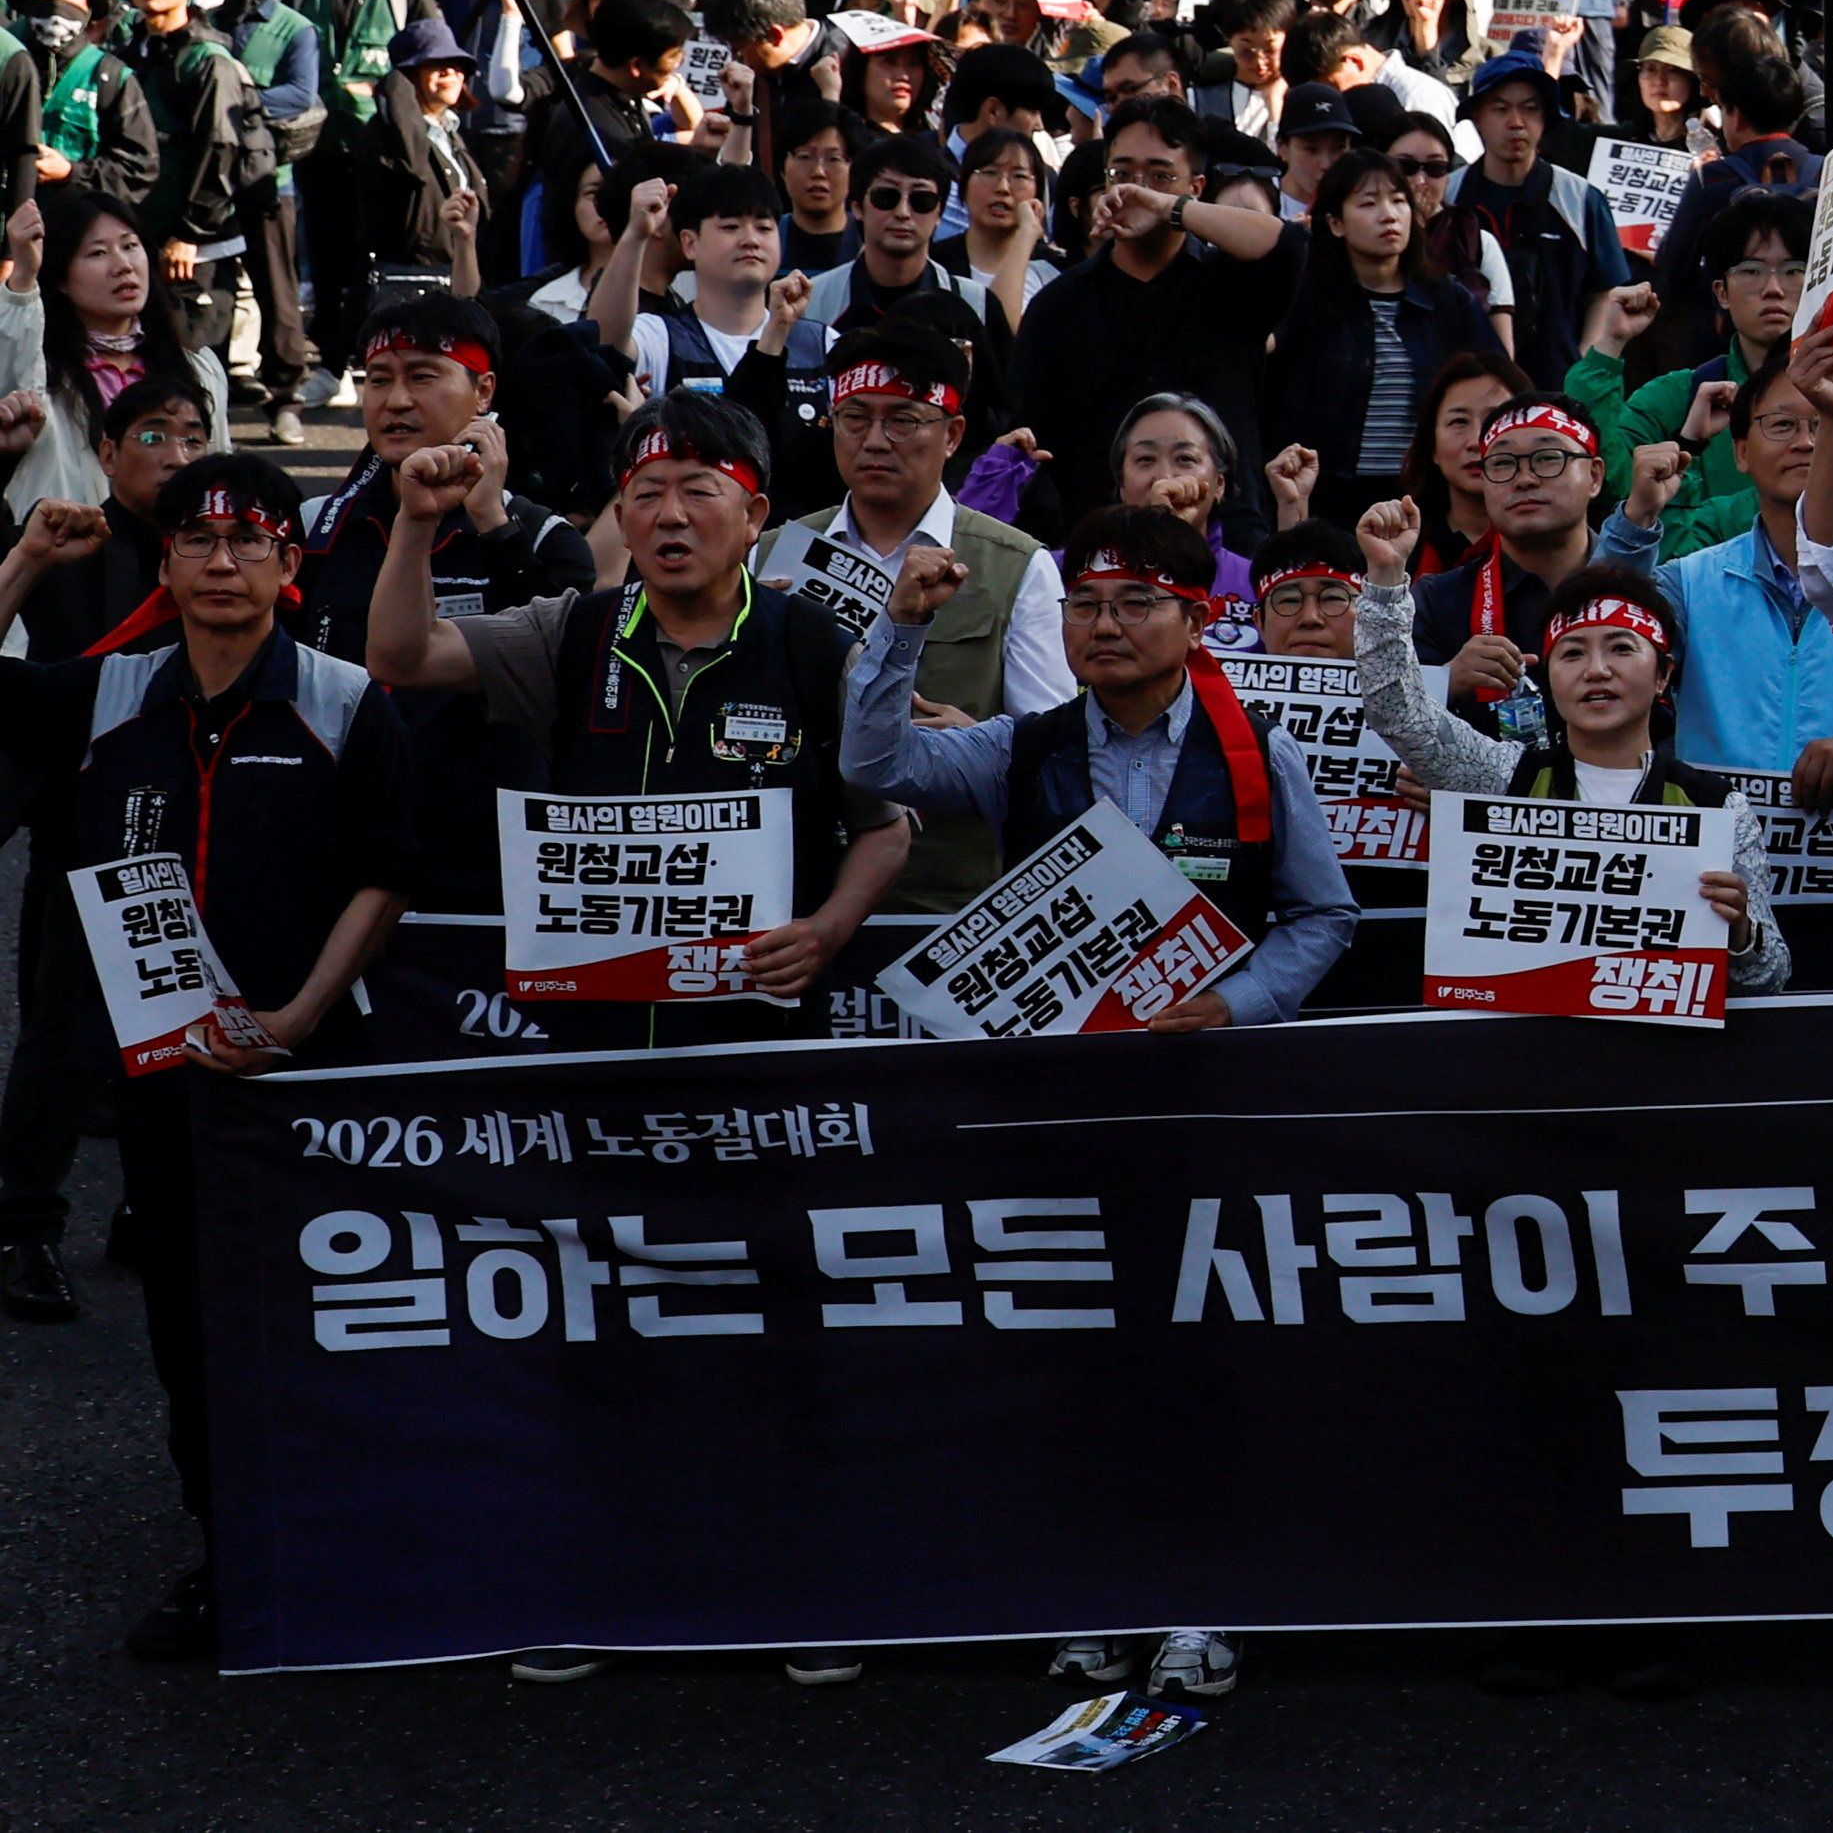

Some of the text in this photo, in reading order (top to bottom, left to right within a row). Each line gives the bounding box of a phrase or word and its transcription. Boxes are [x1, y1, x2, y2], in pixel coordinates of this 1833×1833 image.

[829, 550, 892, 600] 열사의
[1221, 660, 1293, 690] 열사의
[546, 801, 749, 833] 열사의 염원이다!
[1486, 805, 1688, 845] 열사의 염원이다!
[115, 861, 176, 897] 열사의
[993, 842, 1095, 919] 염원이다!
[535, 892, 755, 939] 노동기본권
[1462, 896, 1686, 953] 노동기본권
[926, 912, 994, 972] 열사의
[534, 979, 578, 993] 민주노총
[1111, 914, 1231, 1023] 쟁취!
[1589, 956, 1715, 1017] 쟁취!
[1454, 987, 1496, 1003] 민주노총
[291, 1099, 877, 1169] 2026 세계 노동절대회
[299, 1208, 764, 1354] 일하는
[808, 1196, 1118, 1331] 모든
[1170, 1188, 1633, 1326] 사람이
